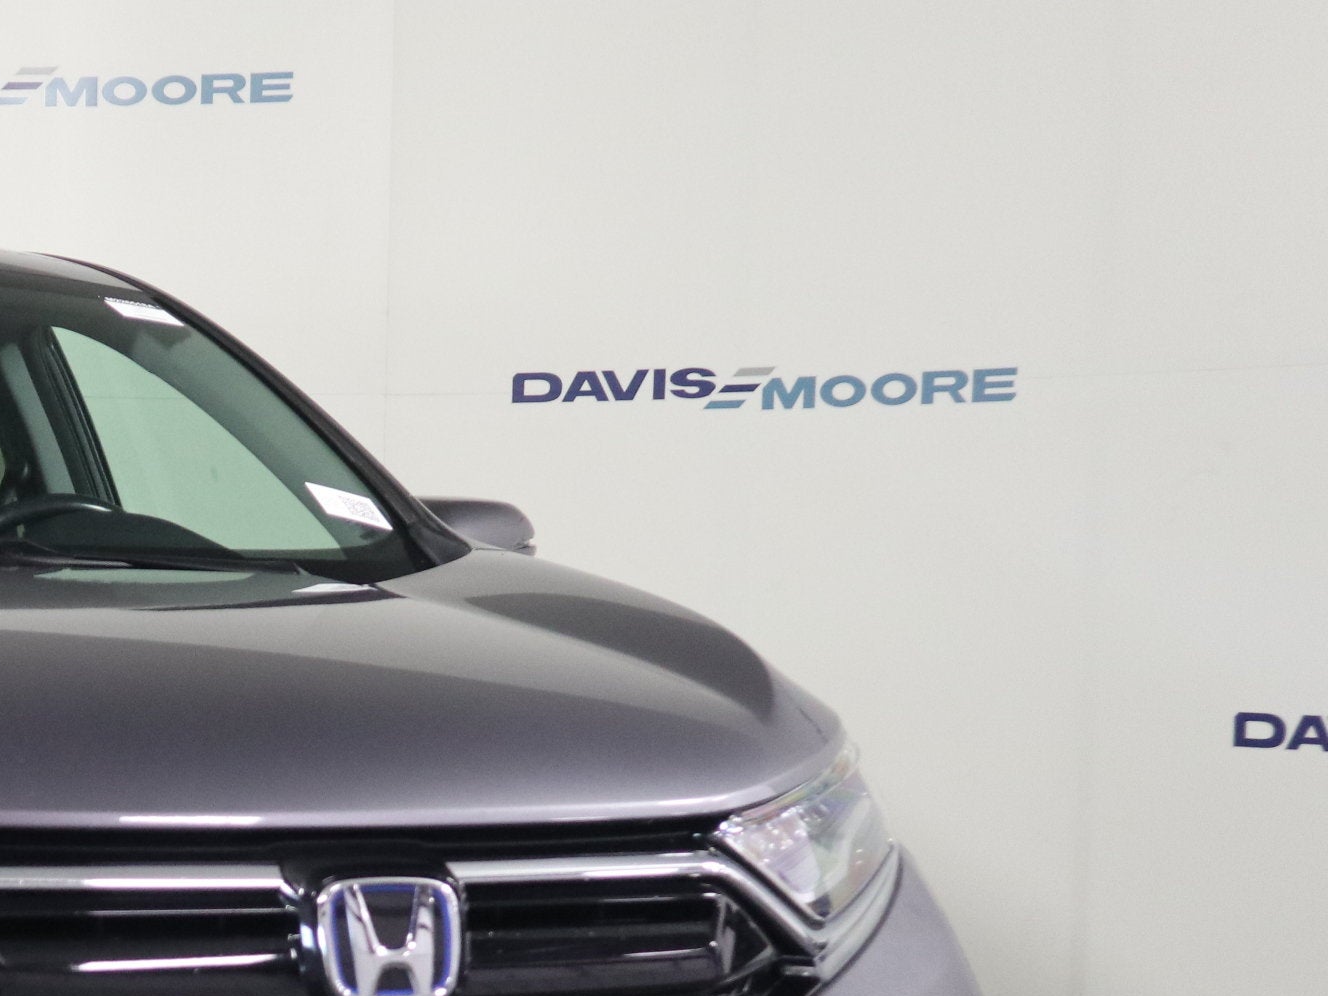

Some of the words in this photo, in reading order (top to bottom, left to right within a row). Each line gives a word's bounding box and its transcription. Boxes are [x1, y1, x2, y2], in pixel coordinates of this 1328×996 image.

[44, 71, 293, 107] MOORE
[511, 367, 719, 404] DAVIS
[761, 367, 1018, 410] MOORE
